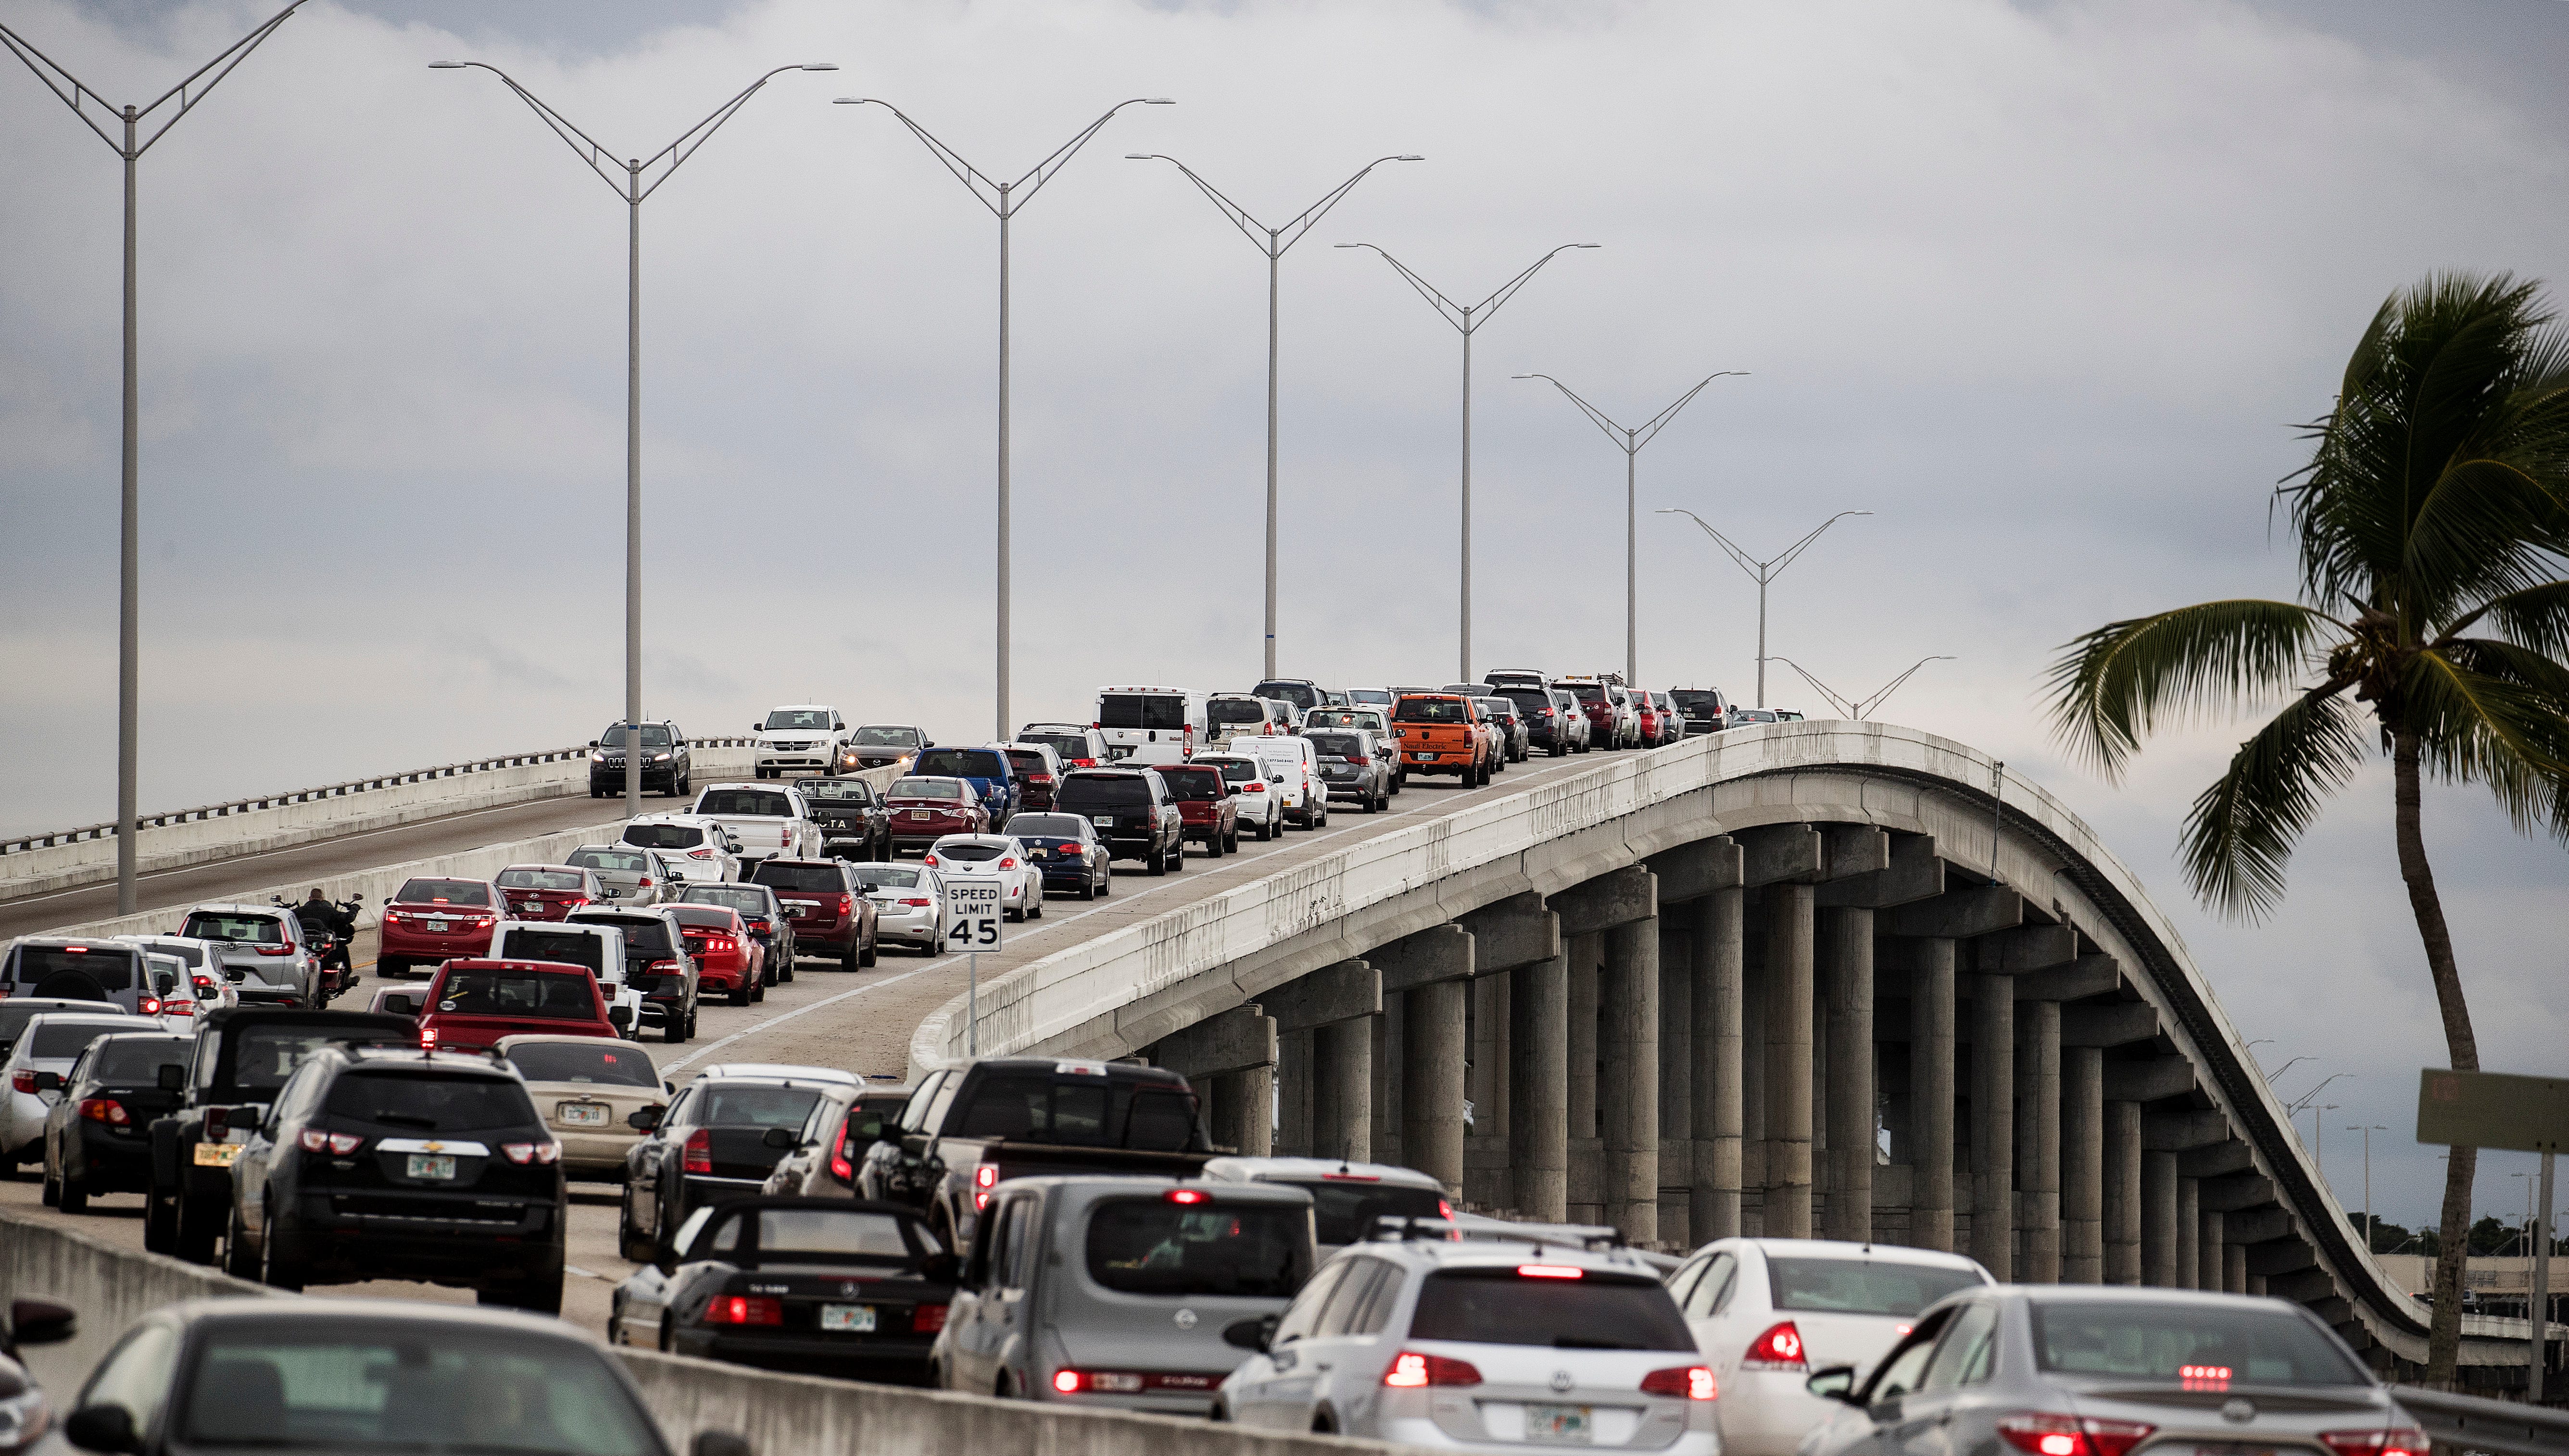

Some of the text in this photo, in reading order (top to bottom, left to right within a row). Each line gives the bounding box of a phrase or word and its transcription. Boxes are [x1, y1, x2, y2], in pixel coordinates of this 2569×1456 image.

[951, 890, 997, 899] SPEED
[956, 904, 992, 914] LIMIT
[949, 919, 997, 944] 45
